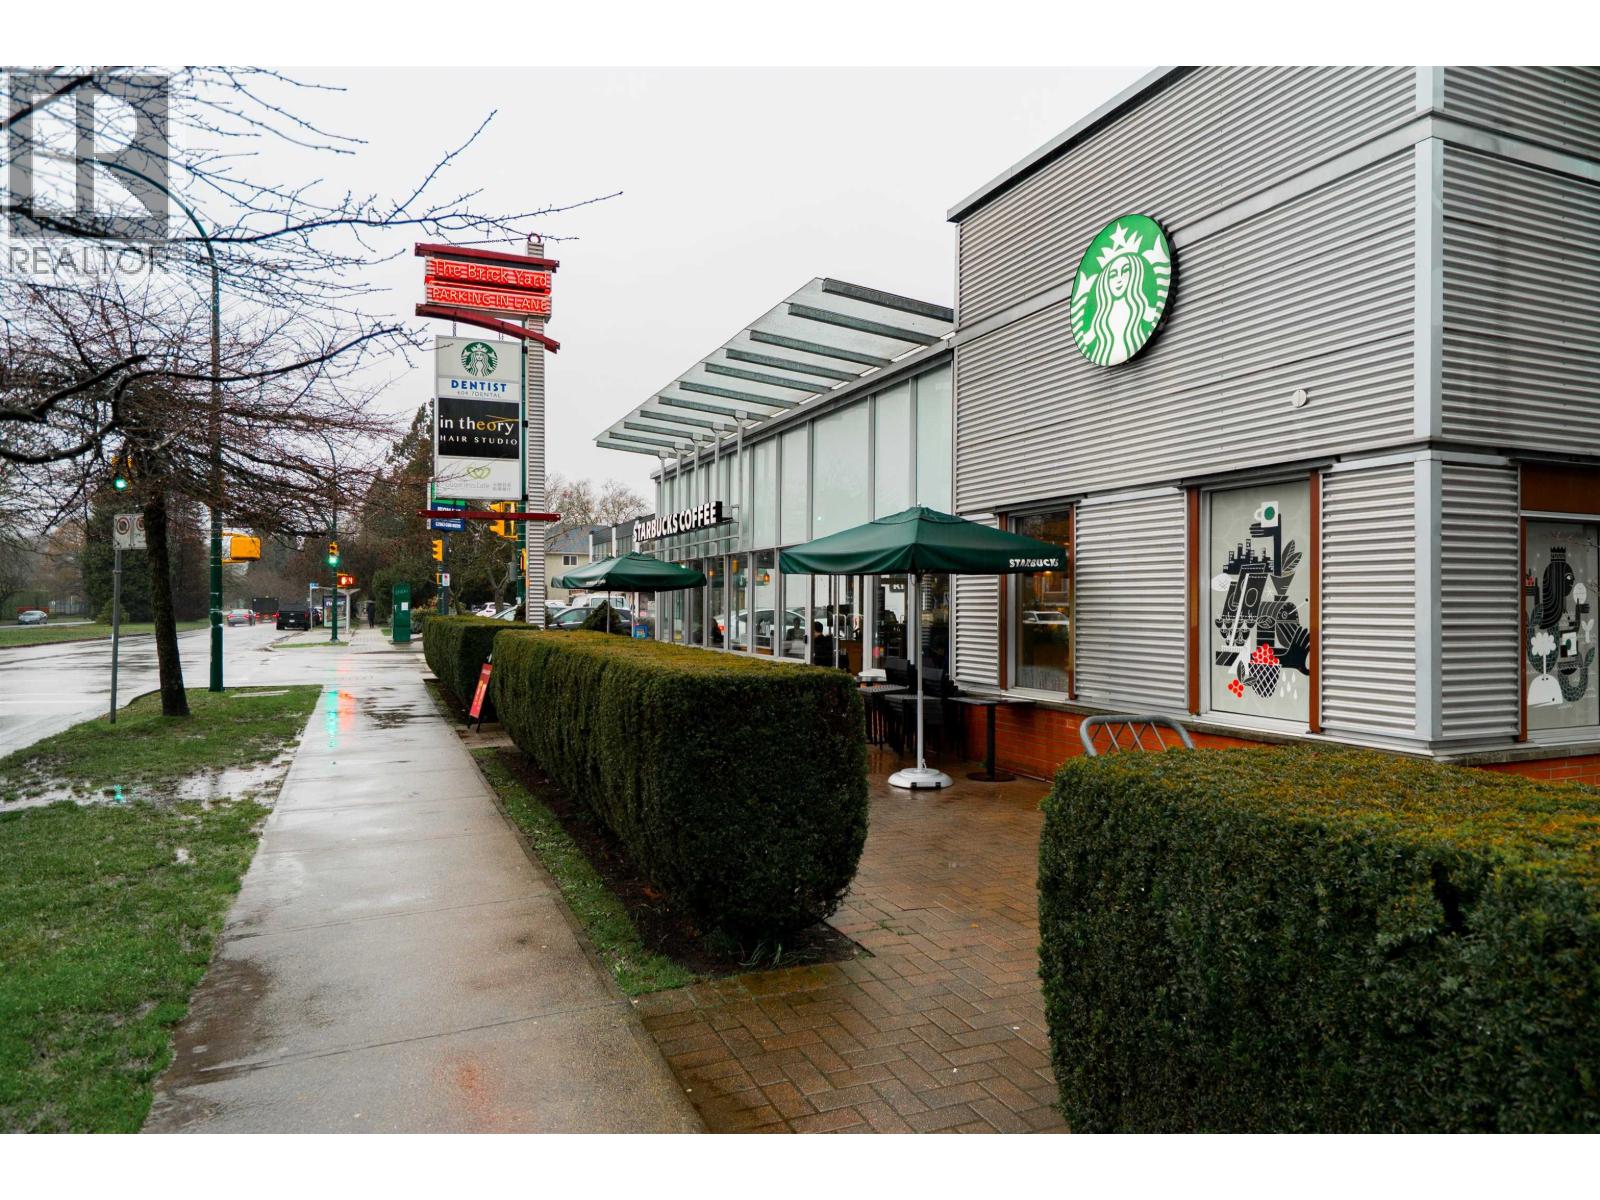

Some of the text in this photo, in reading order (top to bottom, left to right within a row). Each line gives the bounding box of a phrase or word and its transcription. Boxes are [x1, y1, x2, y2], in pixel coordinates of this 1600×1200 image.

[433, 260, 548, 287] The Brick Yard
[432, 287, 548, 312] PARKING IN LANE
[451, 380, 507, 393] DENTIST
[440, 415, 514, 436] in theory
[440, 434, 518, 446] HAIR STUDIO
[633, 502, 717, 542] STARBUCKS COFFEE
